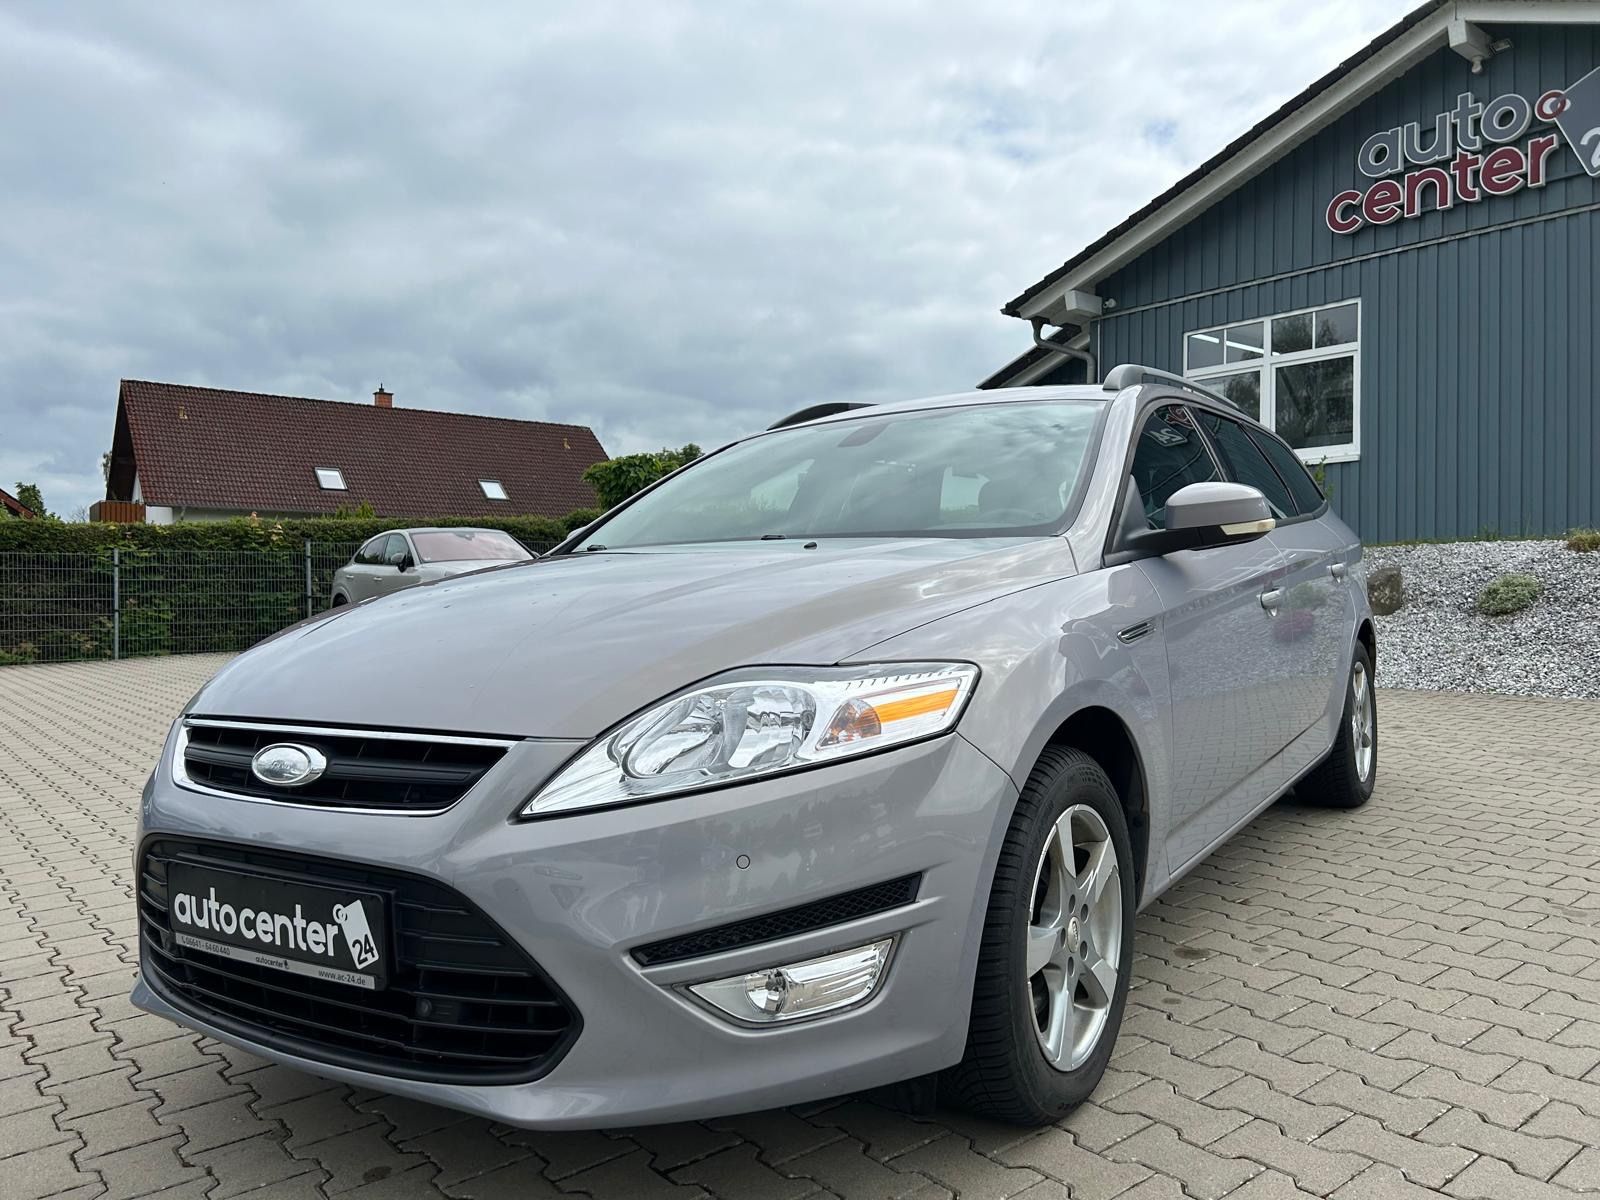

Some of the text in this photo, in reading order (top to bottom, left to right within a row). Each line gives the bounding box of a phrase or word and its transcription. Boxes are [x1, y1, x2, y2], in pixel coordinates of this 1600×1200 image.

[1357, 91, 1532, 178] auto
[1325, 133, 1559, 235] center
[174, 887, 339, 957] autocenter
[255, 955, 284, 968] autocenter
[351, 933, 376, 964] 24
[318, 969, 366, 986] www.ac-24.de
